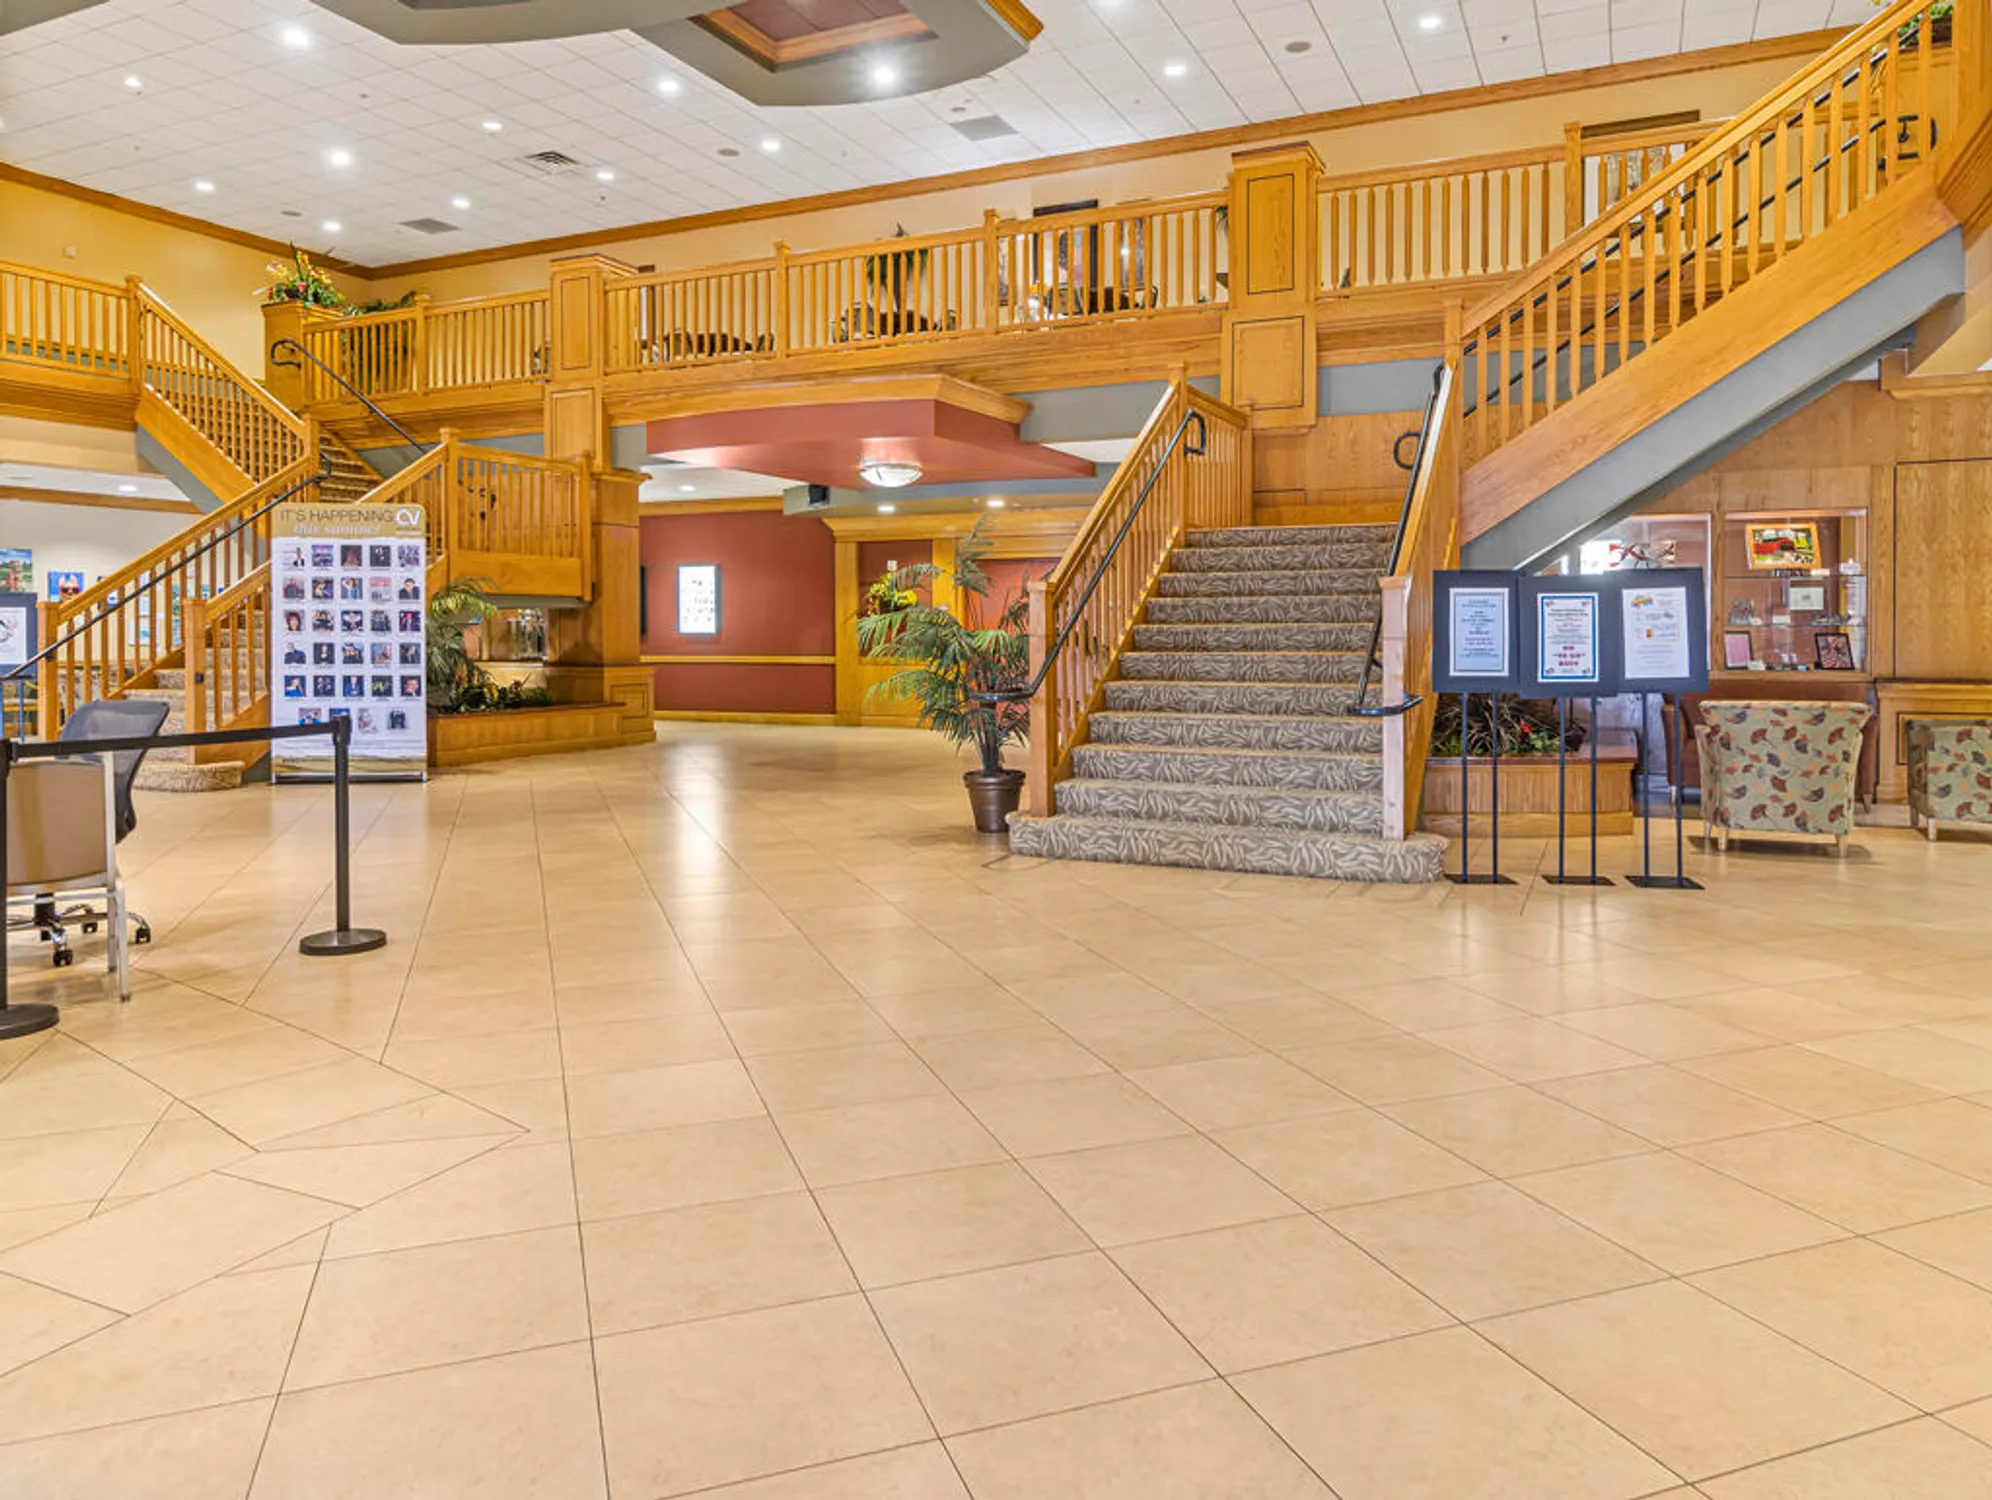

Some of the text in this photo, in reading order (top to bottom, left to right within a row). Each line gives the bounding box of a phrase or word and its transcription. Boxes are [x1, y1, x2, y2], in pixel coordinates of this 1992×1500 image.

[280, 509, 393, 522] IT'S HAPPENING
[323, 524, 380, 535] summer
